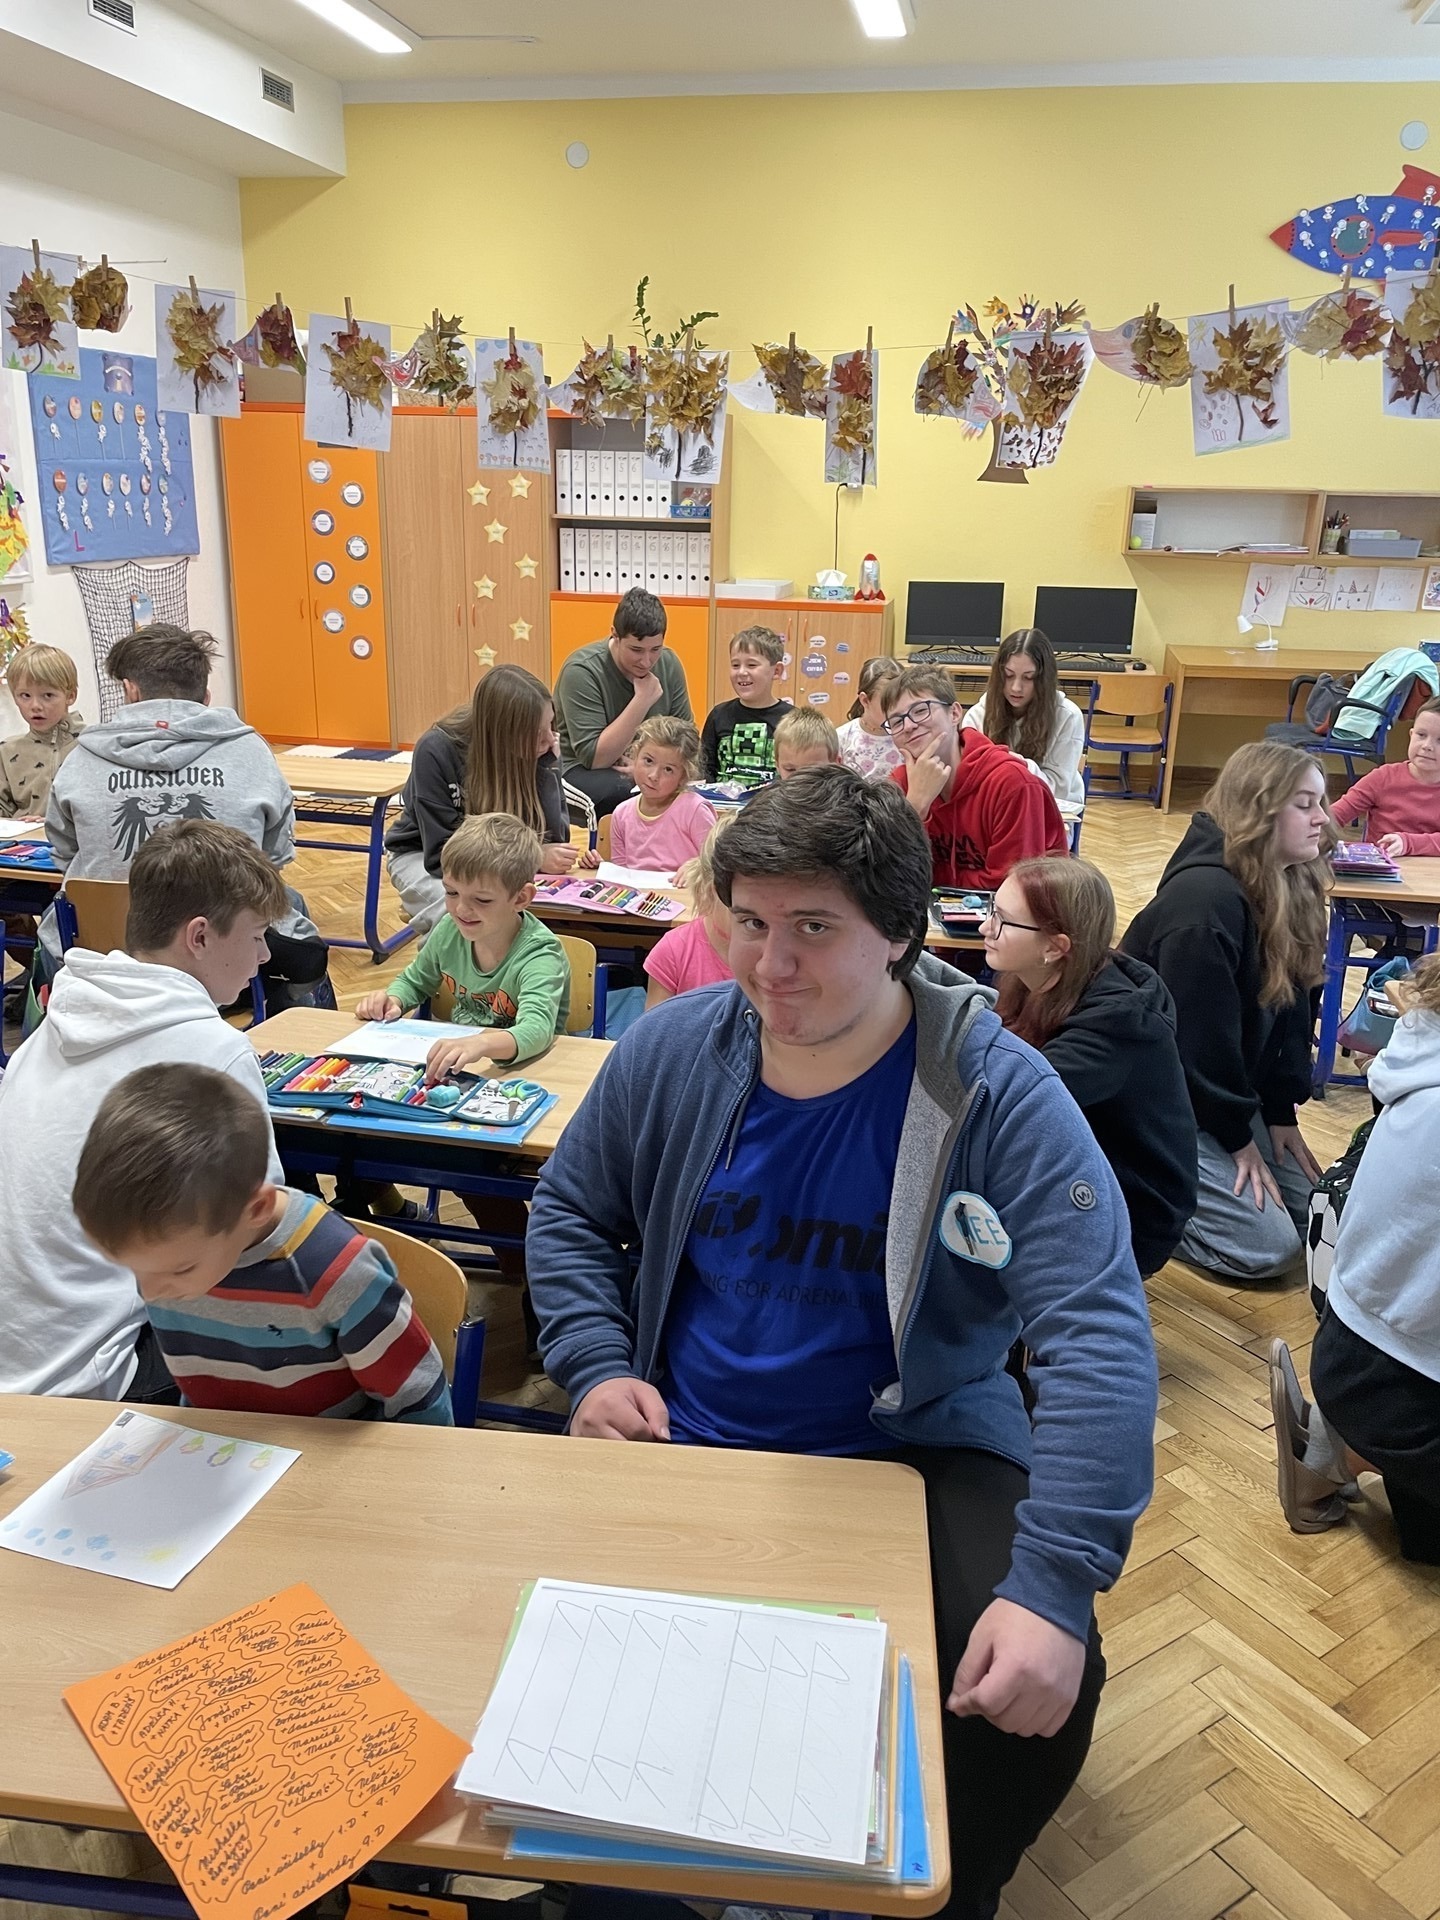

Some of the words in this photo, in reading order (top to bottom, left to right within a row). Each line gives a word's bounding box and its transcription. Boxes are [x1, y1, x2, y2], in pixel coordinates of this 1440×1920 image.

[108, 767, 225, 793] QUIKSILVER
[735, 1279, 772, 1301] FOR
[210, 1605, 260, 1642] program
[170, 1657, 182, 1668] D
[235, 1625, 250, 1635] D
[98, 1710, 115, 1732] ADAM
[222, 1701, 256, 1724] ONDRA
[200, 1724, 255, 1759] Damian
[304, 1734, 346, 1756] Marek
[346, 1817, 357, 1828] D
[389, 1784, 401, 1796] D
[374, 1824, 385, 1837] D
